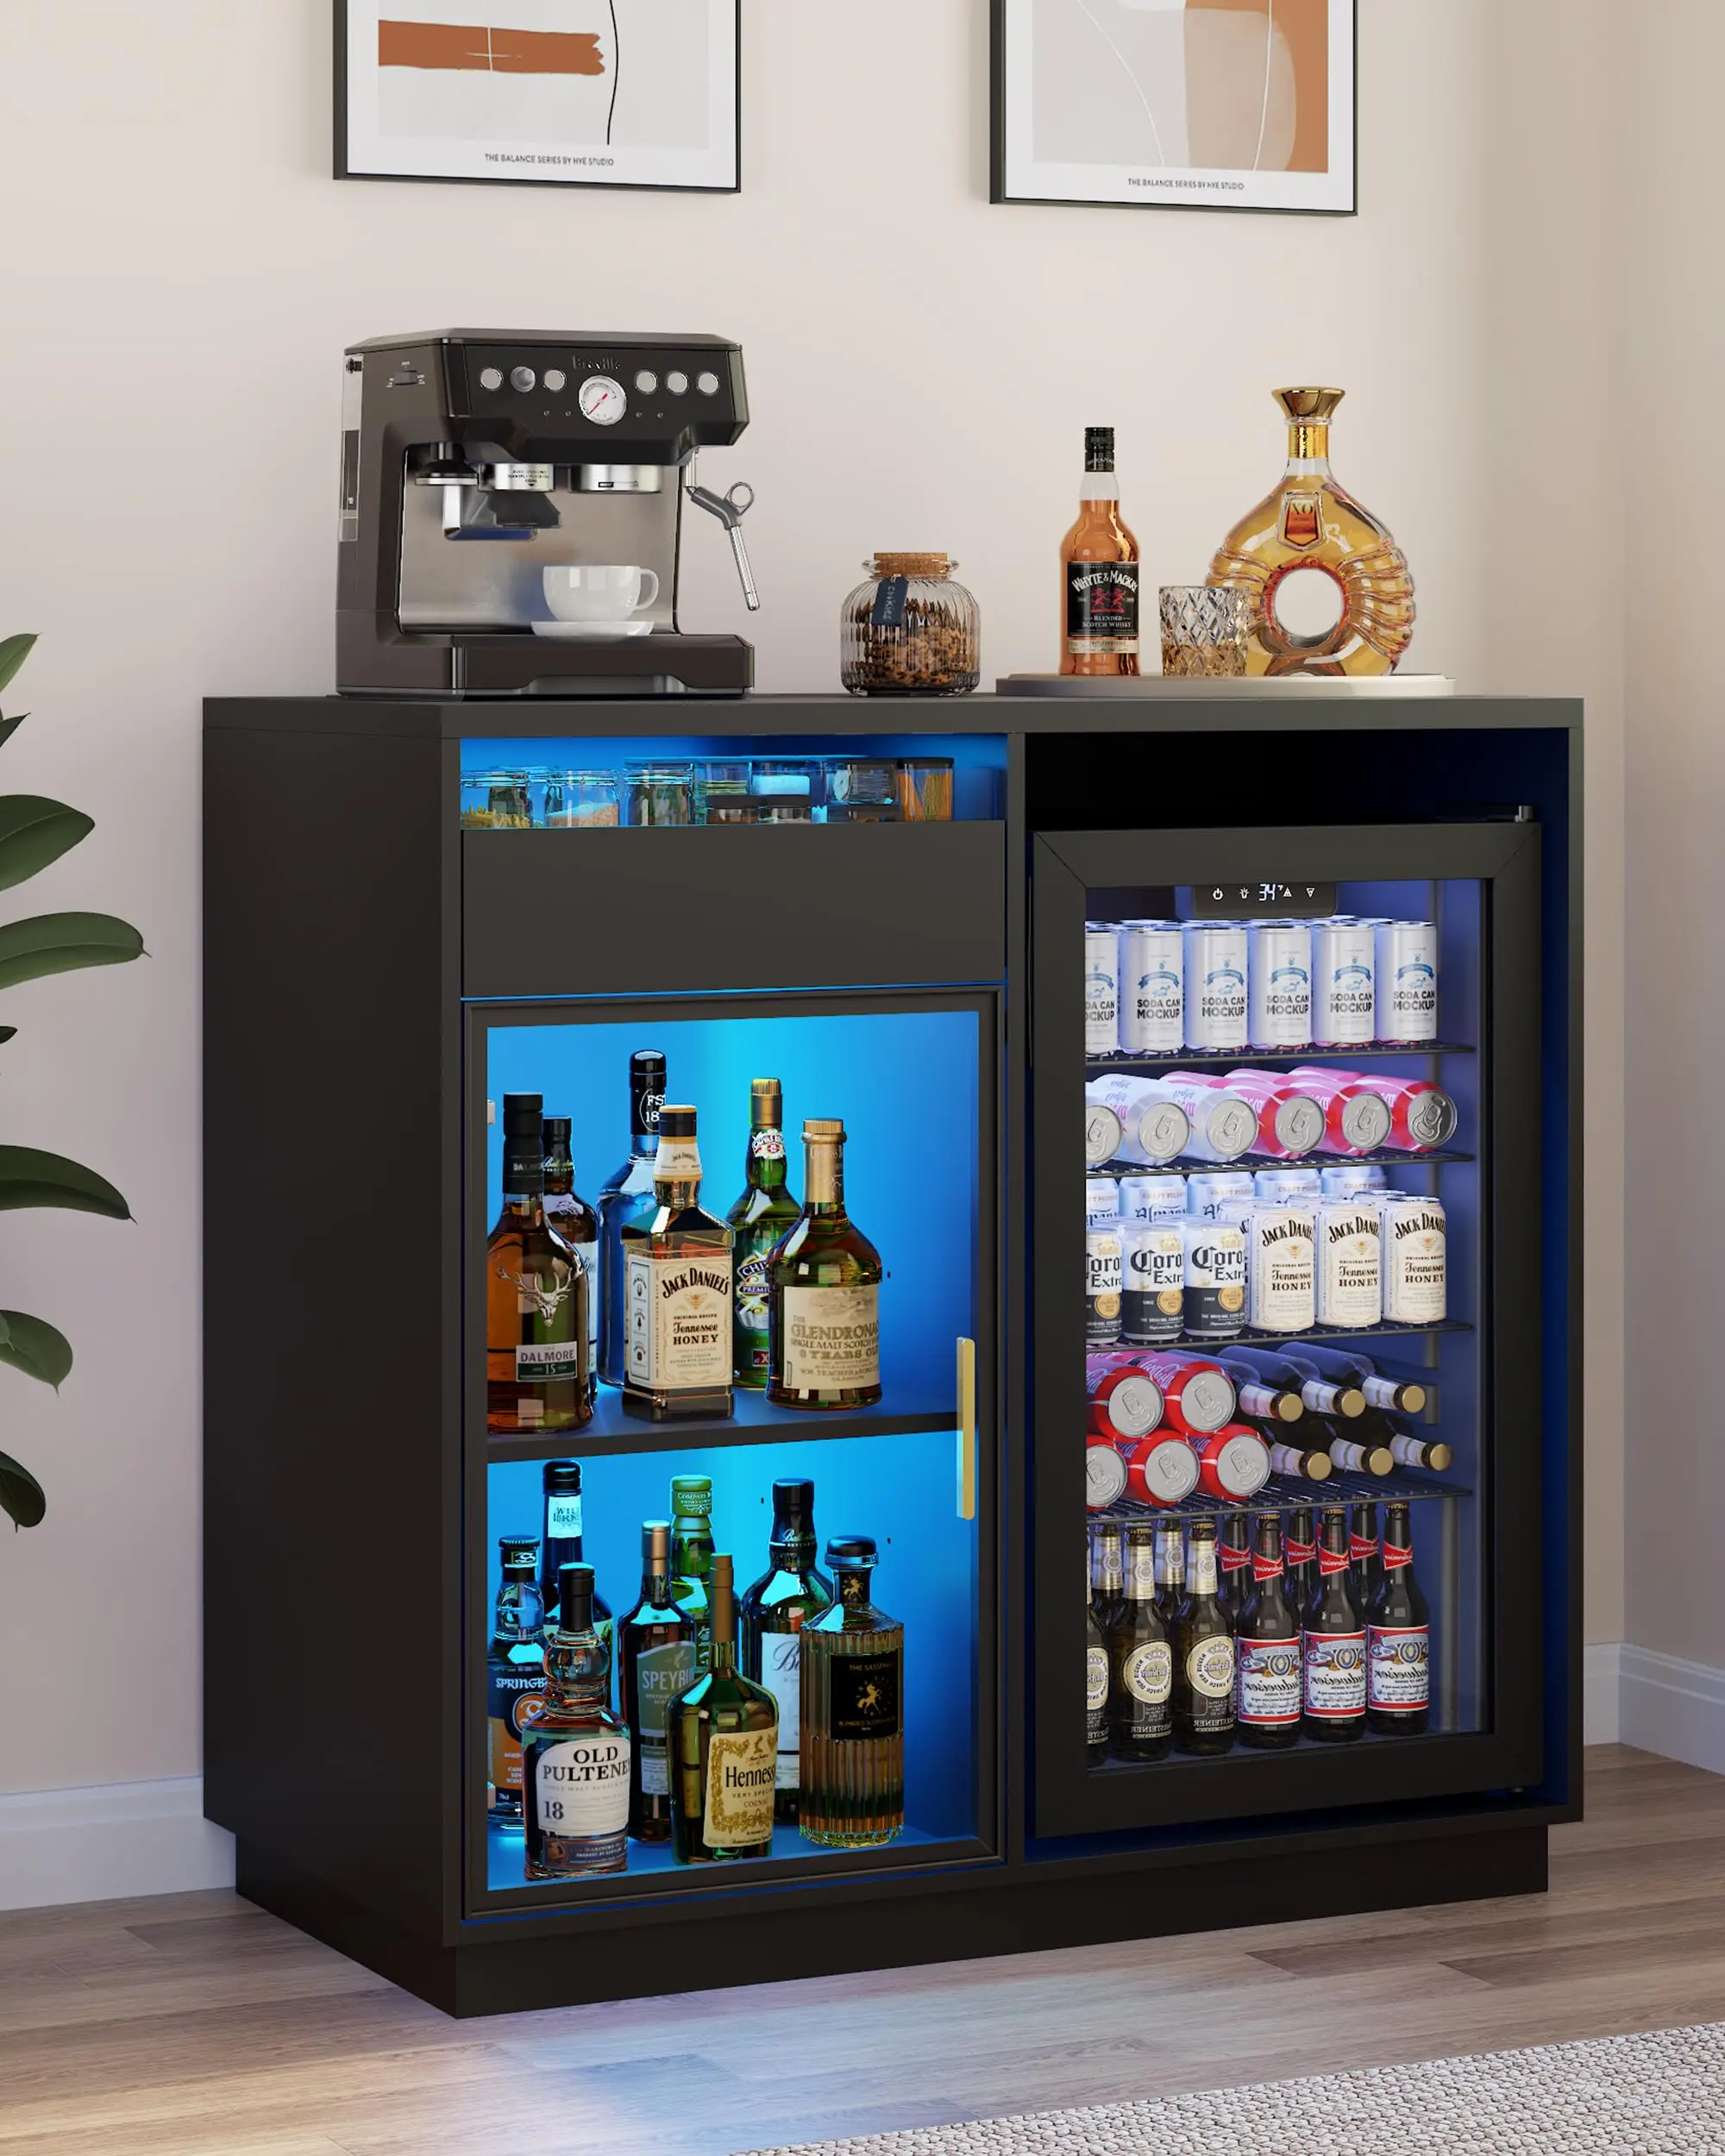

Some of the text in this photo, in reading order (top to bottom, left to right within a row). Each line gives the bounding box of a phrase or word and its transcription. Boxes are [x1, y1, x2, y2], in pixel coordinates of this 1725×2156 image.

[485, 154, 499, 162] THE
[500, 154, 536, 164] BALANCE
[537, 155, 561, 165] SERIES
[563, 156, 572, 165] BY
[588, 157, 614, 166] STUDIO
[1128, 178, 1140, 186] THE
[1142, 179, 1174, 188] BALANCE
[1175, 179, 1196, 189] SERIES
[1198, 180, 1207, 189] BY
[1220, 182, 1245, 191] STUDIO
[1071, 572, 1104, 592] WHYTE
[1202, 996, 1245, 1006] SODA CAN
[1266, 993, 1309, 1004] SODA CAN
[1330, 993, 1373, 1002] SODA CAN
[1393, 990, 1435, 1000] SODA CAN
[1085, 1000, 1115, 1010] DA CAN
[1137, 998, 1181, 1008] SODA CAN
[1330, 1002, 1373, 1012] MOCKUP
[1393, 1000, 1435, 1011] MOCKUP
[1137, 1008, 1180, 1019] MOCKUP
[1202, 1006, 1245, 1017] MOCKUP
[1266, 1004, 1308, 1015] MOCKUP
[645, 1111, 660, 1123] 18
[1328, 1221, 1355, 1244] JACK
[1395, 1218, 1421, 1240] JACK
[1261, 1225, 1288, 1247] JACK
[1130, 1249, 1183, 1275] Coro
[1191, 1245, 1244, 1272] Coro
[1153, 1270, 1183, 1284] Extr
[1214, 1267, 1245, 1281] Extr
[1405, 1273, 1445, 1283] HONEY
[662, 1273, 688, 1299] JACK
[1271, 1282, 1312, 1291] HONEY
[1339, 1276, 1378, 1287] HONEY
[673, 1321, 718, 1334] Tennessee
[673, 1334, 719, 1345] HONEY
[520, 1349, 575, 1363] DALMORE
[809, 1349, 862, 1360] YEARS
[545, 1363, 556, 1375] 15
[573, 1746, 618, 1764] OLD
[543, 1758, 630, 1782] PULTENE
[725, 1764, 775, 1788] Henness
[544, 1801, 564, 1820] 18
